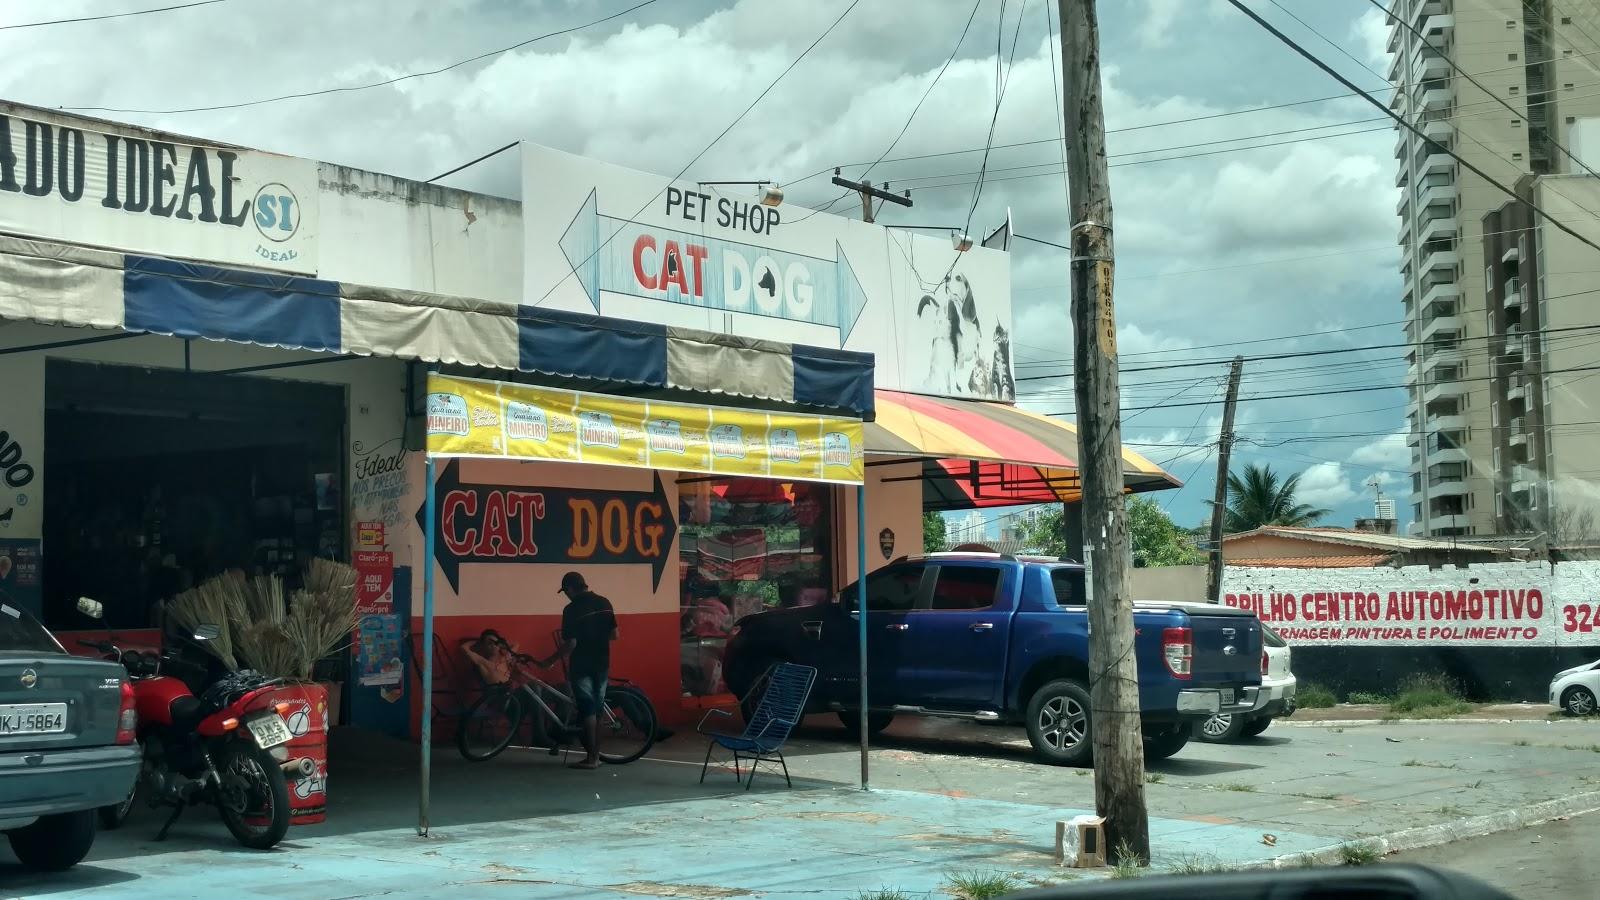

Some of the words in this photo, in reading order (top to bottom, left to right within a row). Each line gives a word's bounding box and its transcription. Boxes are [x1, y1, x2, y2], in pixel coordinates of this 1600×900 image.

[102, 133, 251, 228] IDEAL
[255, 193, 294, 231] SI
[665, 186, 712, 223] PET
[716, 197, 781, 236] SHOP
[255, 244, 298, 262] IDEAL
[631, 233, 709, 297] CAT
[722, 247, 814, 318] DOG
[427, 415, 468, 433] MINEIRO
[509, 421, 547, 439] MINEIRO
[583, 427, 619, 445] MINEIRO
[354, 446, 408, 480] Ideal
[442, 489, 545, 557] CAT
[567, 498, 665, 557] DOG
[364, 574, 383, 584] AQUI
[365, 583, 381, 593] TEM
[1301, 592, 1381, 621] CENTRO
[1385, 588, 1544, 621] AUTOMOTIVO
[1345, 625, 1413, 640] PINTURA
[1416, 626, 1427, 640] E
[1429, 625, 1539, 640] POLIMENTO
[0, 713, 62, 731] KJ-5864
